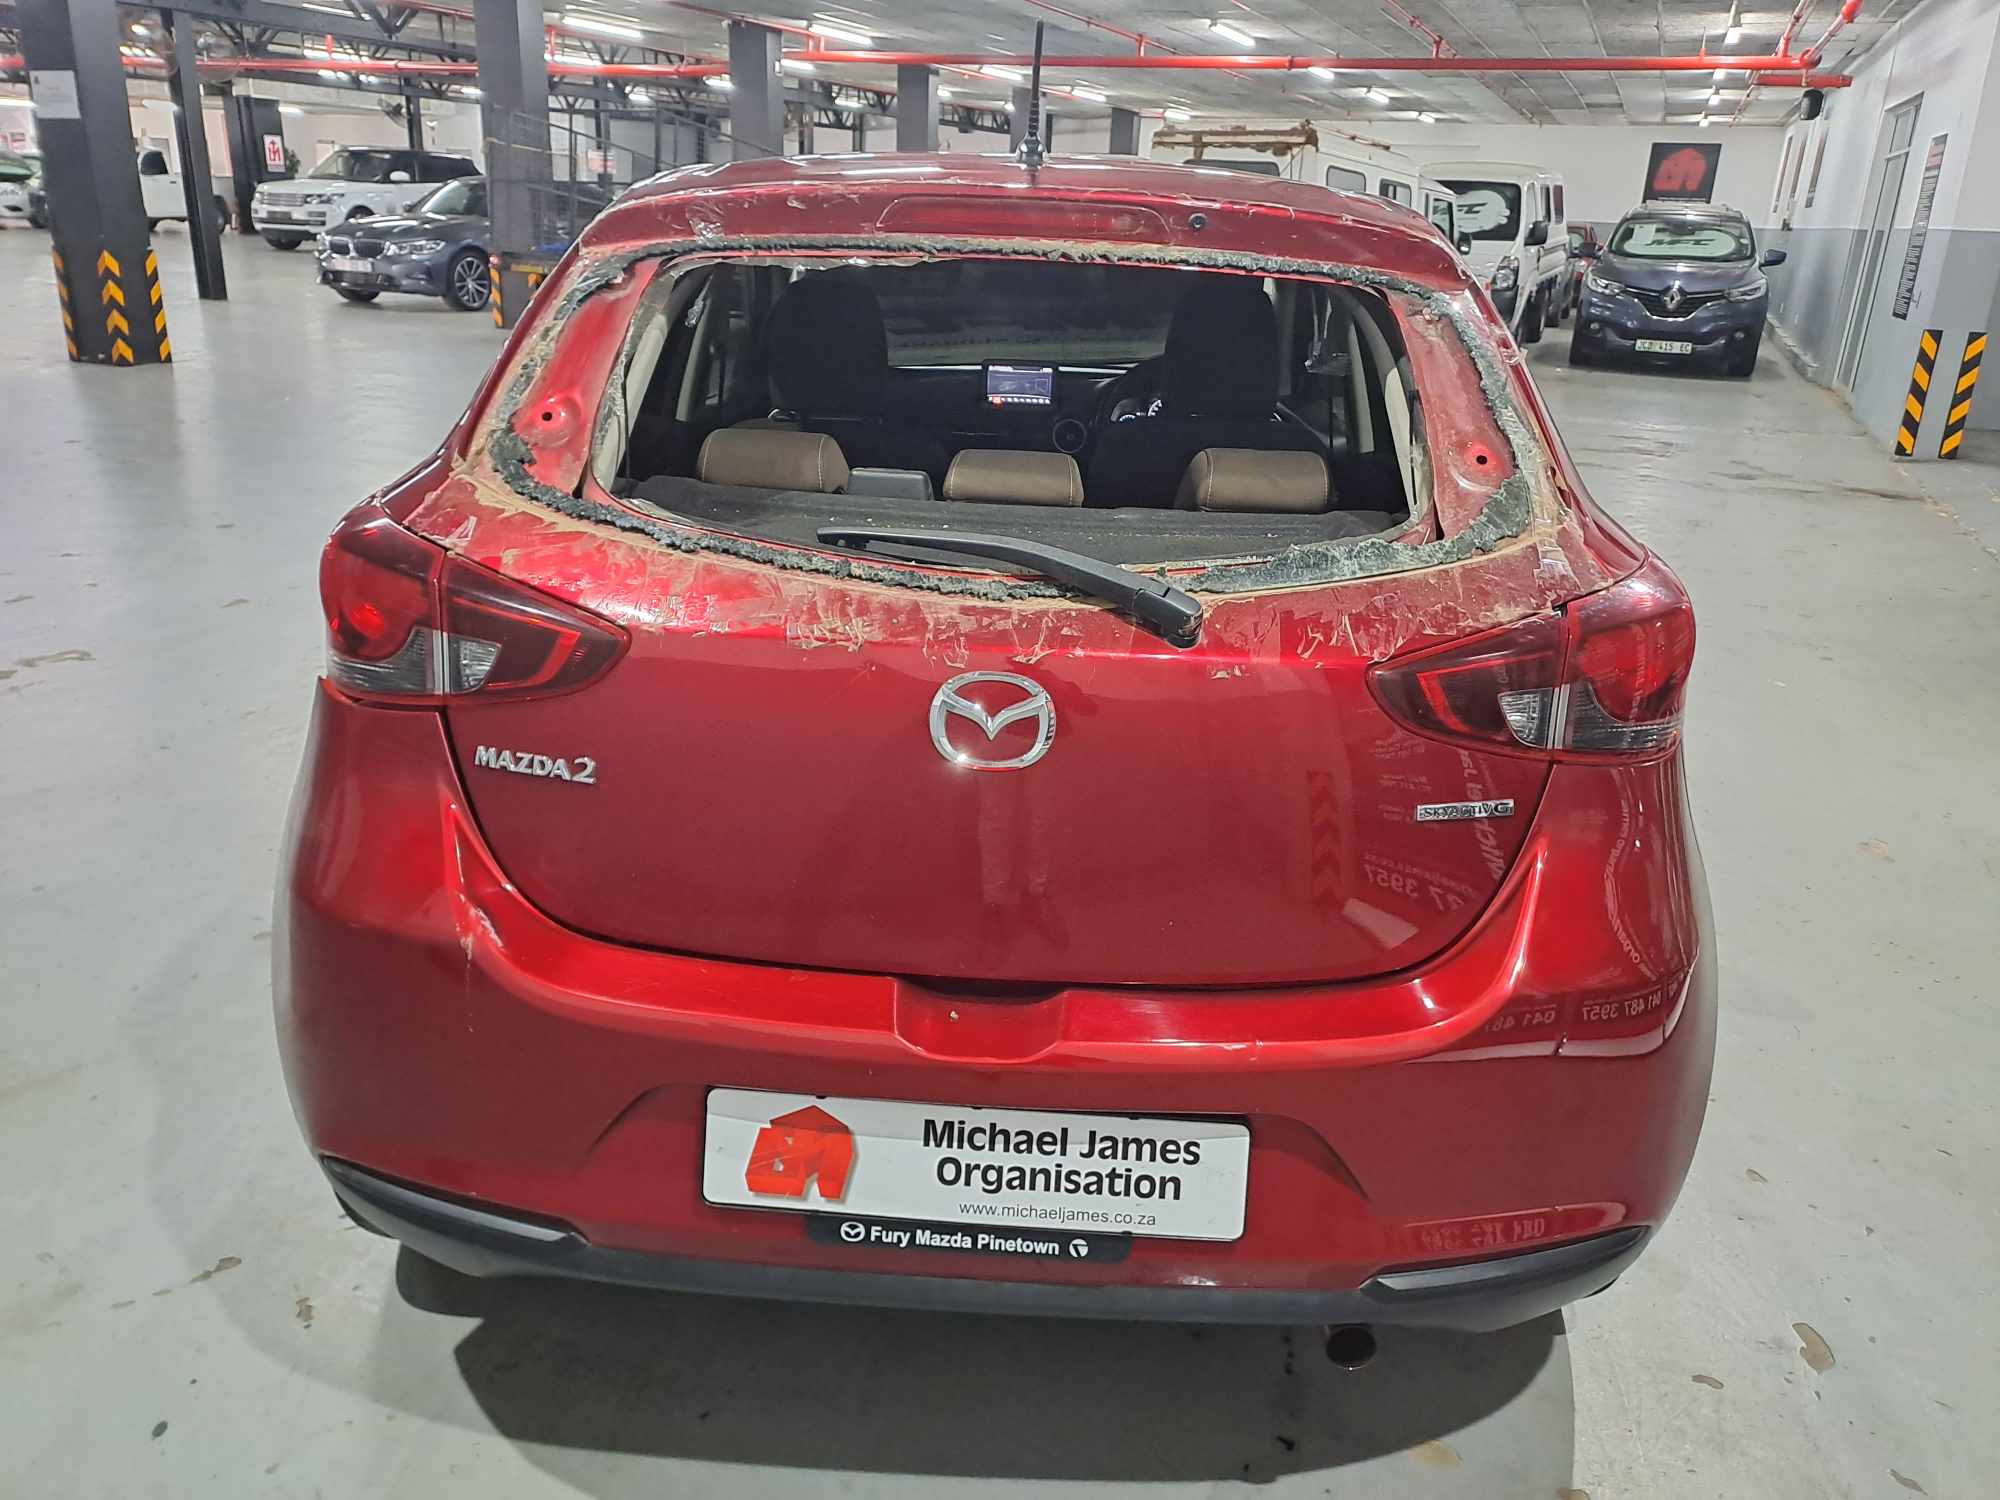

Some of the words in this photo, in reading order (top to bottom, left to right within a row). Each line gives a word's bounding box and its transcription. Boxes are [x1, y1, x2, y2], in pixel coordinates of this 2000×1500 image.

[922, 1118, 1069, 1157] Michael
[1079, 1129, 1201, 1166] James
[936, 1156, 1182, 1201] Organisation
[959, 1203, 1156, 1227] www.michaeljames.co.za
[869, 1224, 912, 1249] Fury
[916, 1229, 972, 1249] Mazda
[977, 1233, 1060, 1255] Pinetown
